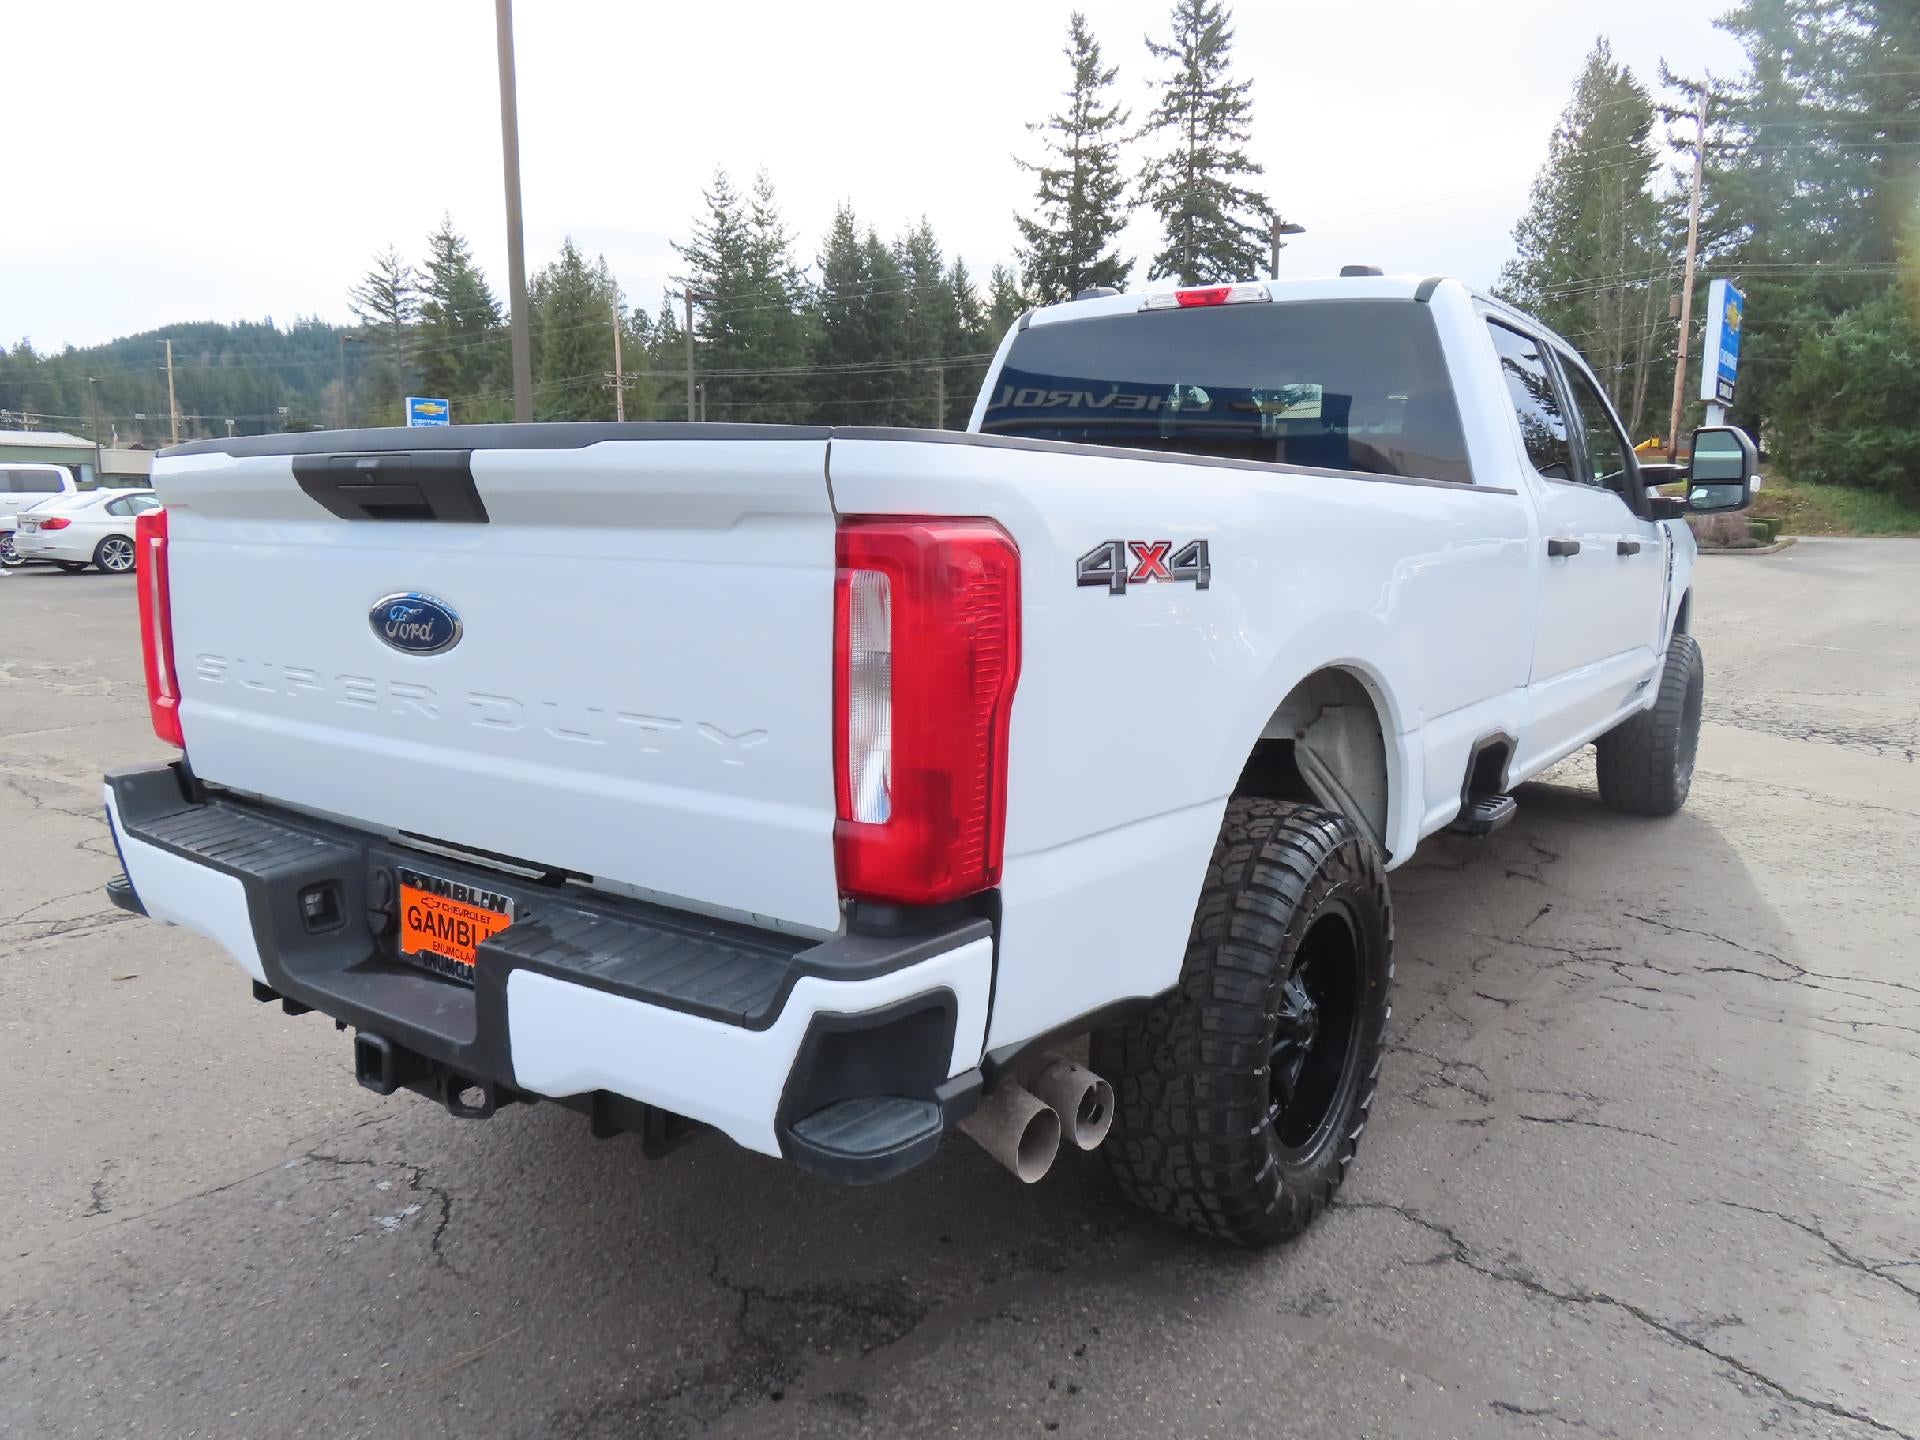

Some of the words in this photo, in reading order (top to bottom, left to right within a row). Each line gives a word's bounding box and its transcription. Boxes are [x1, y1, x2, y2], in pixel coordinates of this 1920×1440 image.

[386, 605, 436, 641] Ford
[196, 652, 440, 719] SUPER
[468, 691, 769, 766] DUTY
[407, 905, 495, 950] GAMBL
[441, 901, 491, 924] CHEVROLET
